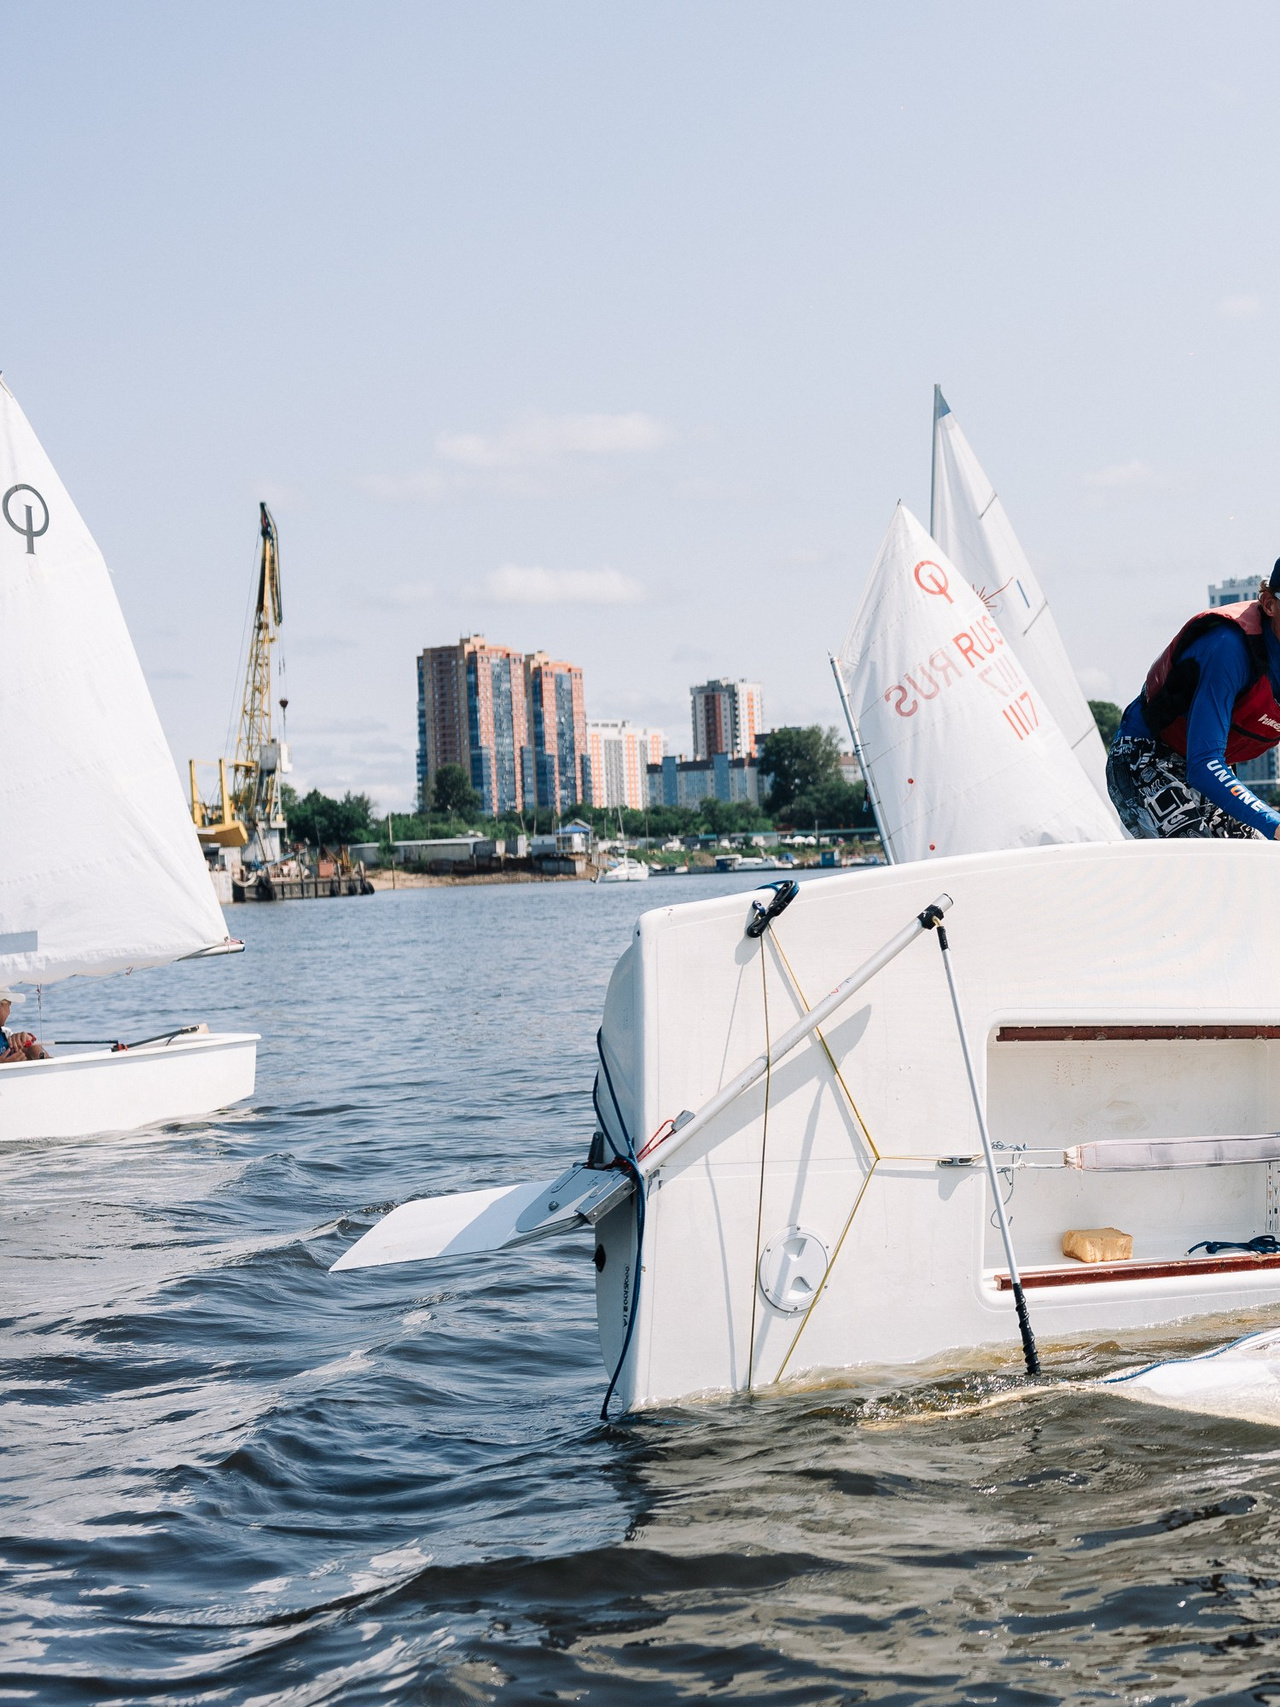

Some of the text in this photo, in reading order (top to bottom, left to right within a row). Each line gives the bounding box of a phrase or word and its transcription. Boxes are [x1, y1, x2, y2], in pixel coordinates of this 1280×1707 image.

[952, 615, 1004, 668] RUS
[1002, 691, 1039, 741] 1117
[1206, 759, 1267, 813] UNIONE
